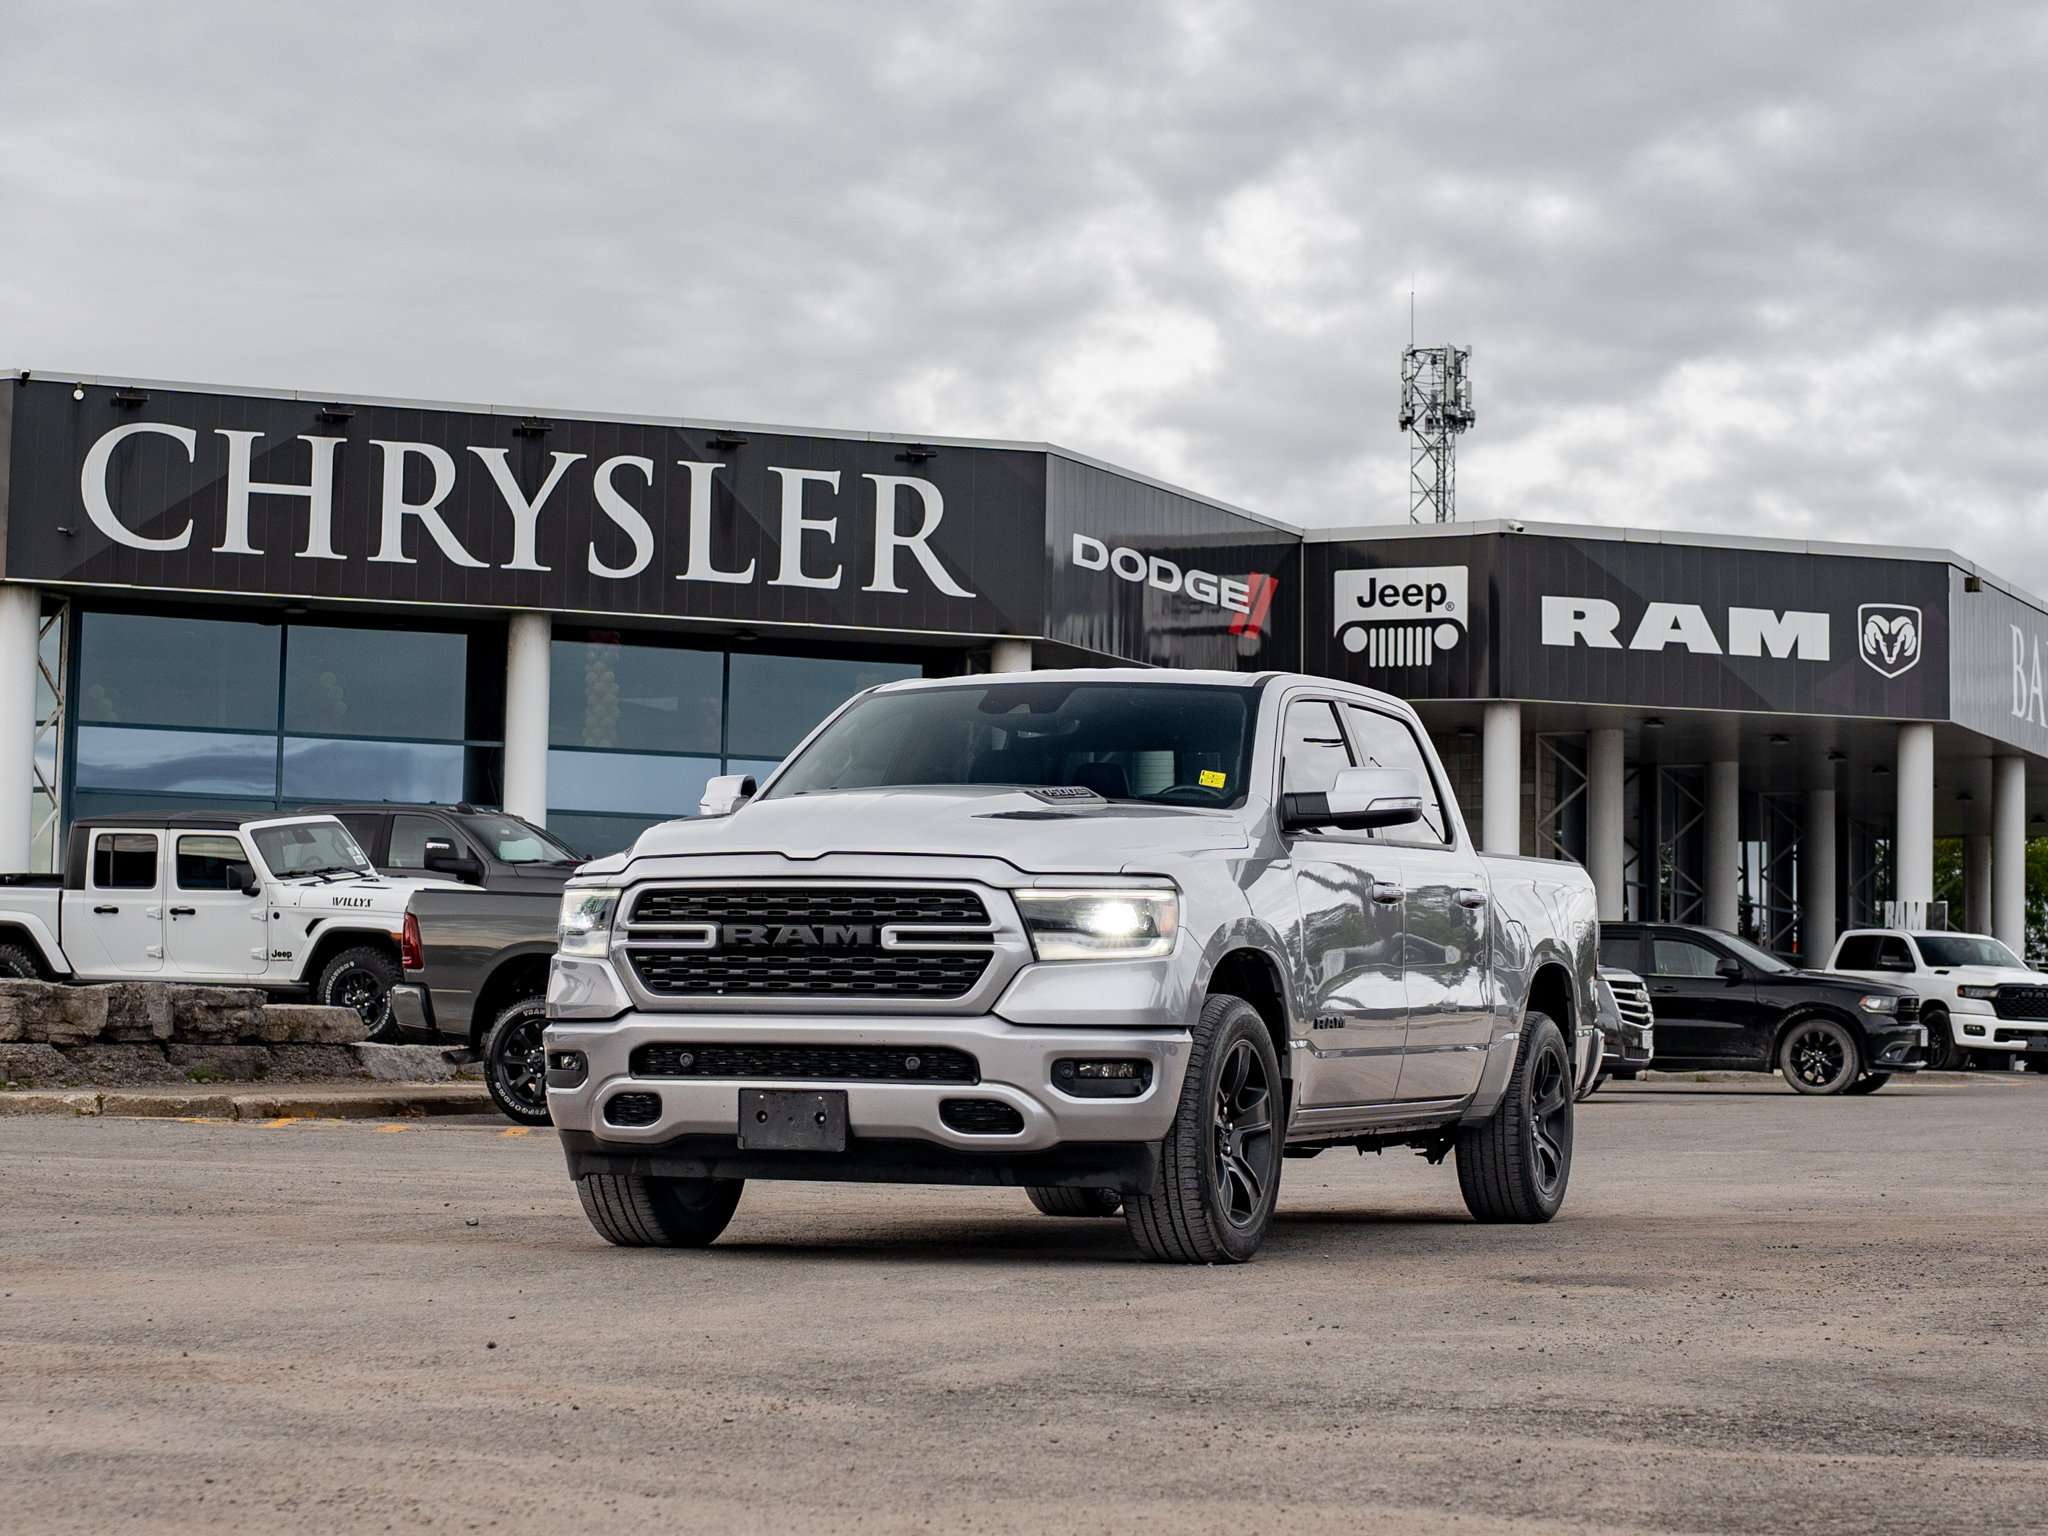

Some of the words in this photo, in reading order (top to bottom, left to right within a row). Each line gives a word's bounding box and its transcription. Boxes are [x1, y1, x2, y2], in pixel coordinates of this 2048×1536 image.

[80, 422, 977, 598] CHRYSLER
[1072, 533, 1250, 615] DODGE
[1357, 577, 1447, 613] Jeep
[1541, 595, 1830, 661] RAM
[2009, 623, 2048, 728] BA
[1885, 901, 1927, 929] RAM
[723, 924, 873, 945] RAM
[271, 949, 293, 959] Jeep
[1313, 1017, 1345, 1030] RAM
